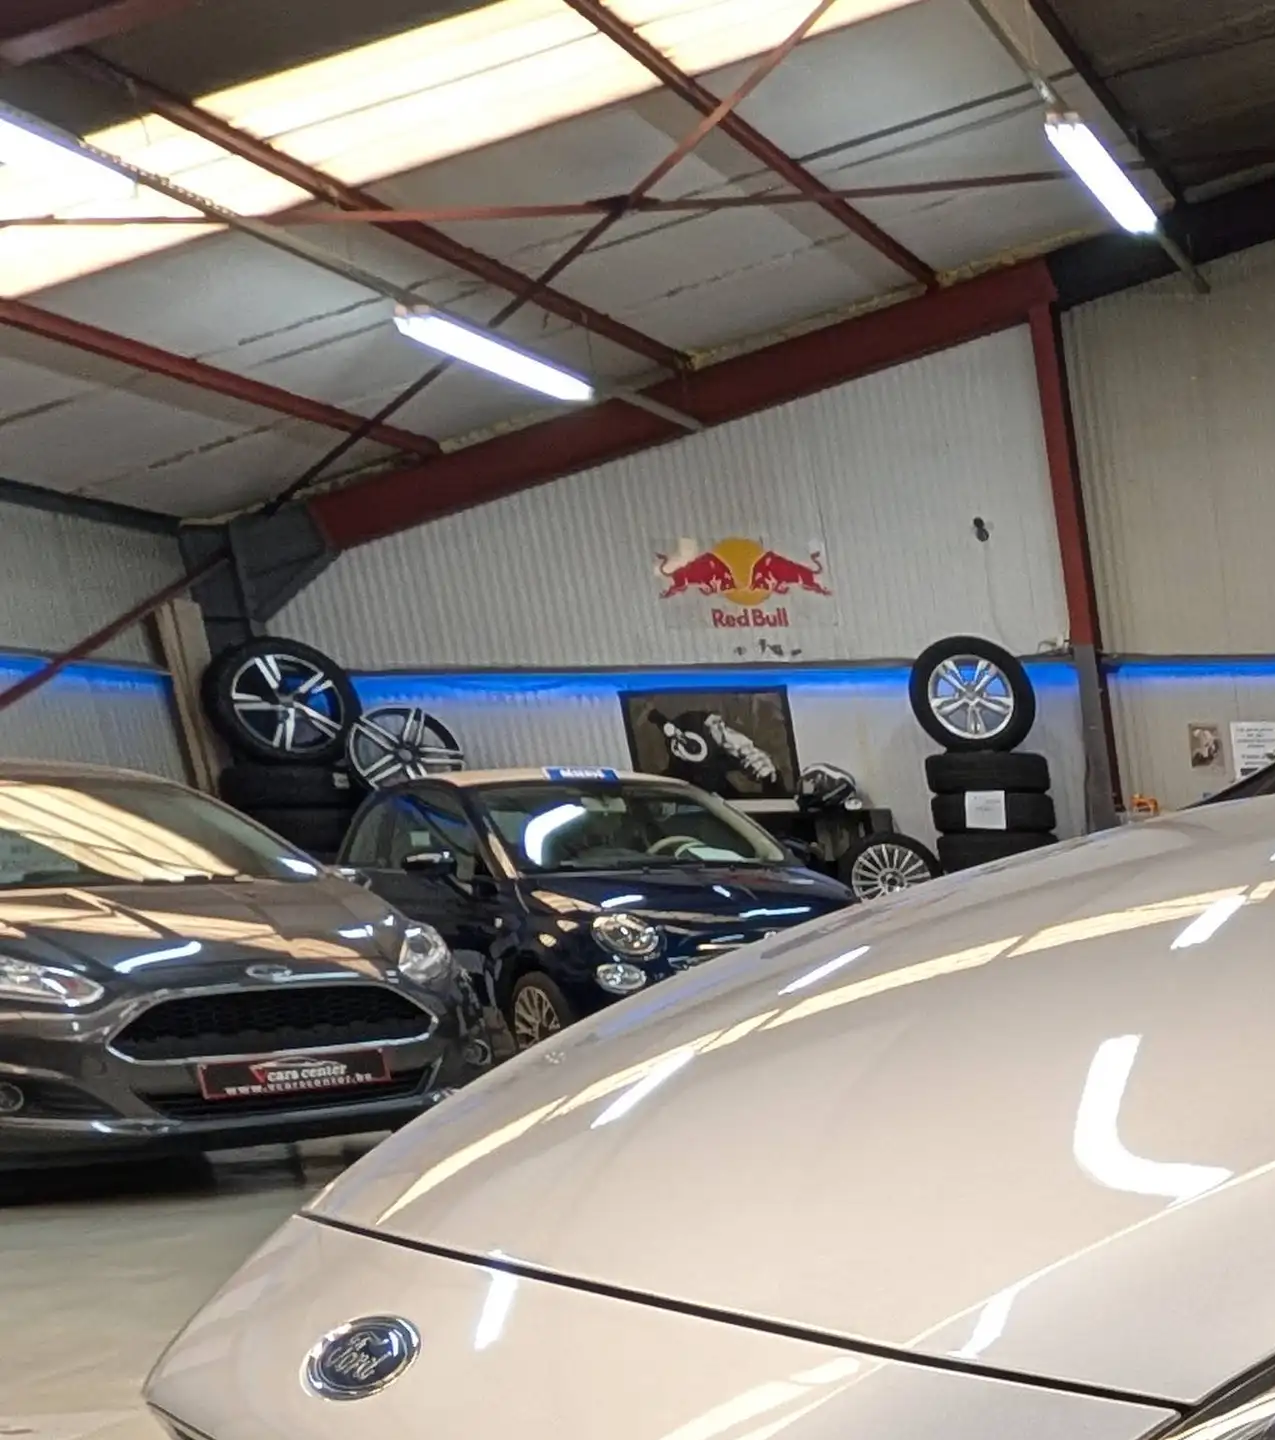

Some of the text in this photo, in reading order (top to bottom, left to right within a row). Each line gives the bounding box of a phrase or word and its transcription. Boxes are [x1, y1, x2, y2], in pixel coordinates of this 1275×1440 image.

[711, 606, 789, 628] Red Bull
[301, 1063, 348, 1080] center
